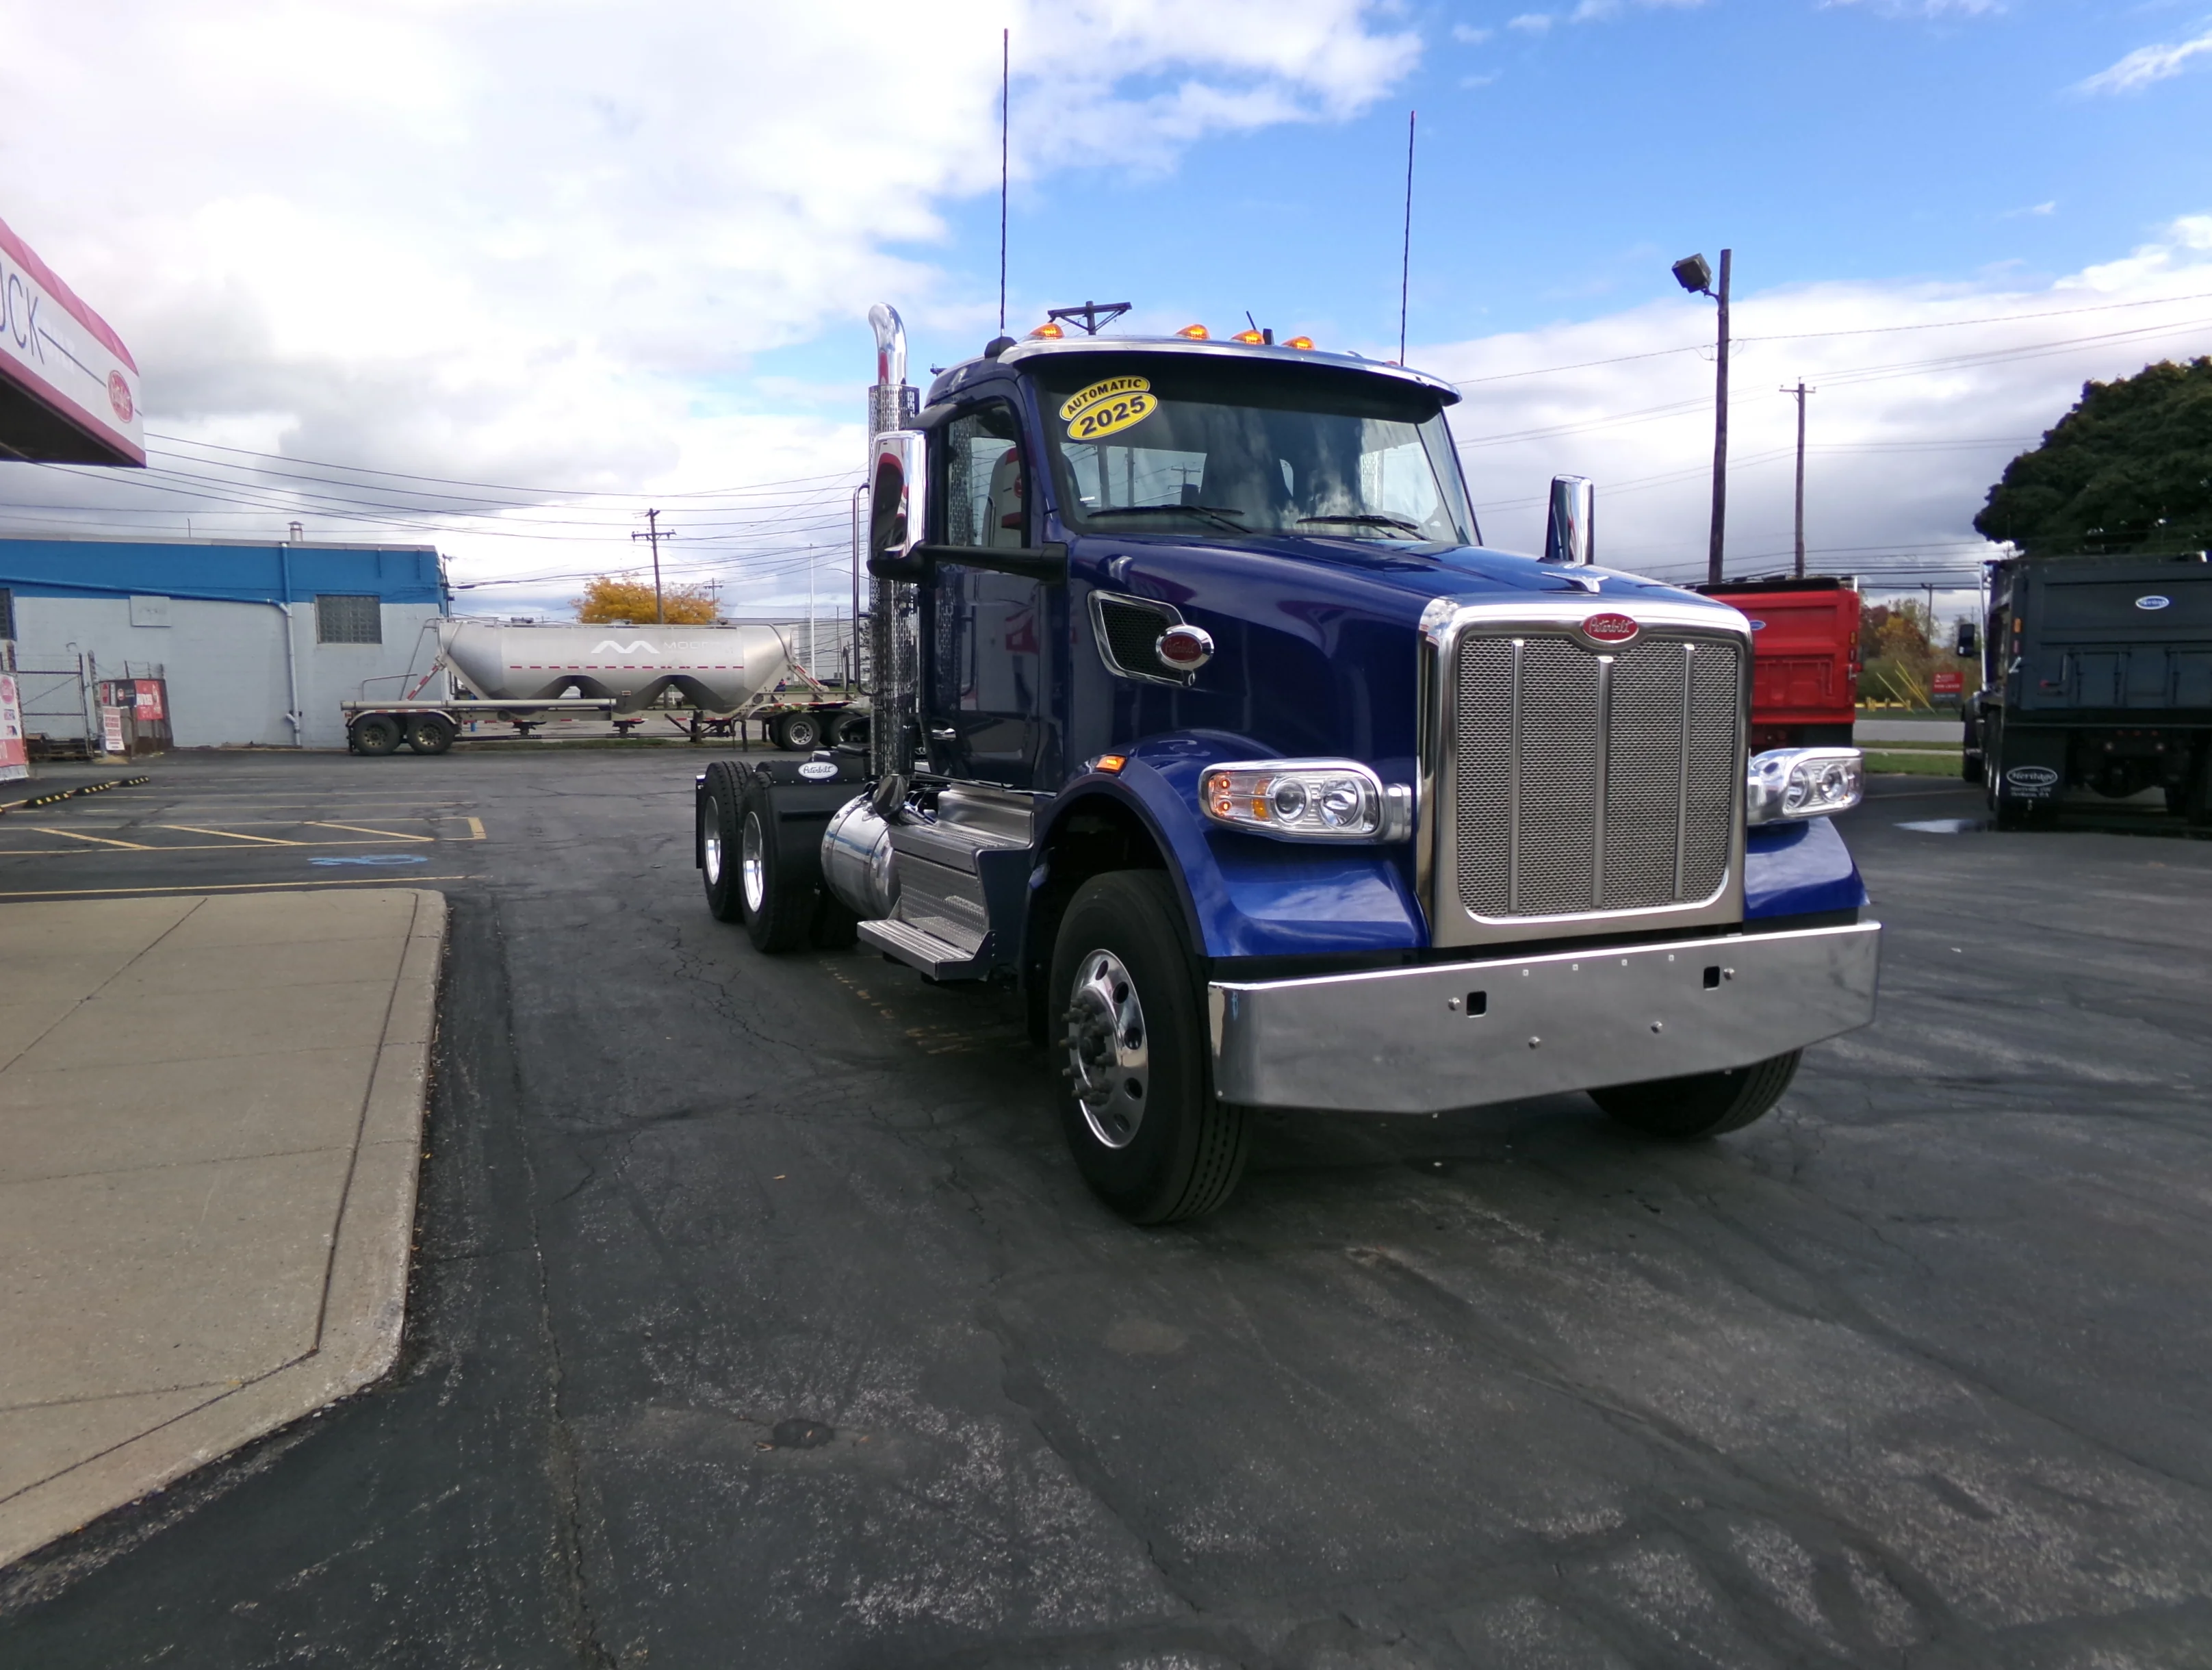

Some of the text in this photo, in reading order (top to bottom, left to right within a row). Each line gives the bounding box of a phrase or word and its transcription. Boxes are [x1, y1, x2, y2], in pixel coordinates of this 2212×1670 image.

[1067, 378, 1142, 415] AUTOMATIC
[1079, 395, 1146, 437] 2025
[1589, 617, 1634, 634] Peterbilt
[803, 765, 834, 774] Peterbilt
